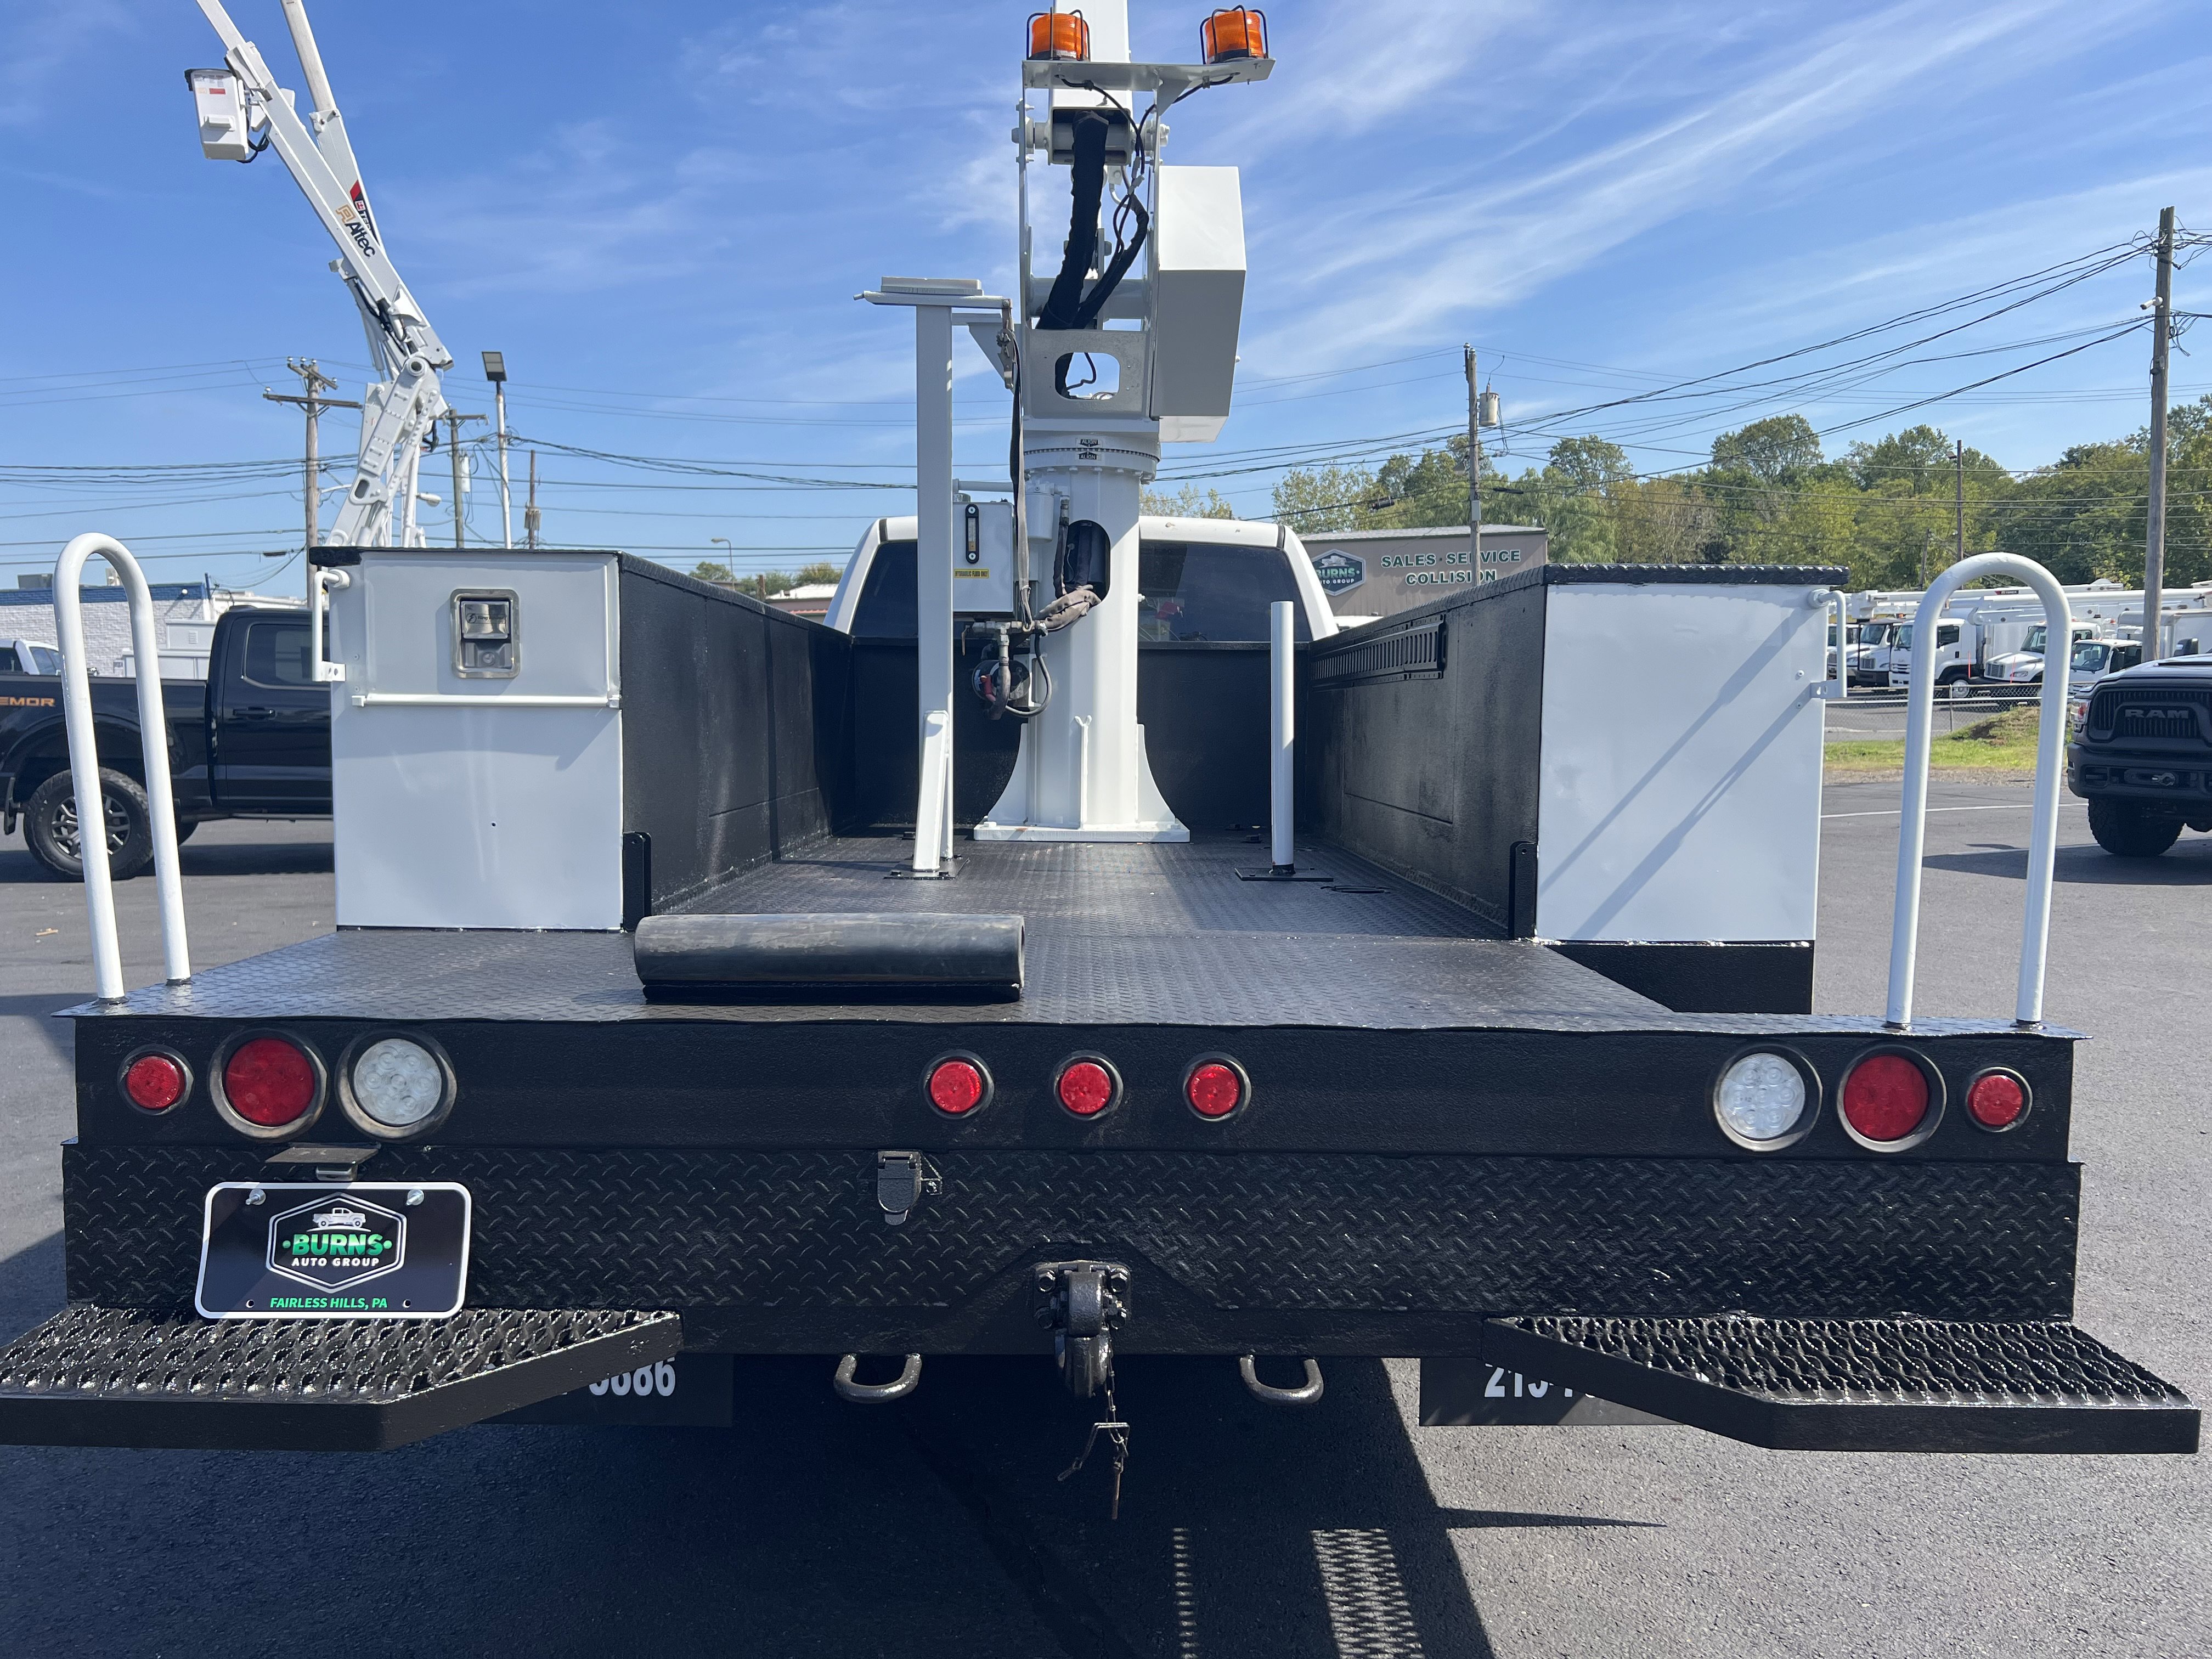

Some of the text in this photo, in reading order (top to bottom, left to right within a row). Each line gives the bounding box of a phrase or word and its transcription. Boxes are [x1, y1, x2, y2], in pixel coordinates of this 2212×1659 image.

[345, 222, 375, 257] Altec
[1381, 553, 1436, 568] SALES
[0, 696, 55, 707] EMOR
[2125, 709, 2189, 719] RAM
[292, 1233, 383, 1256] BURNS
[291, 1257, 380, 1267] AUTO GROUP
[270, 1297, 388, 1310] FAIRLESS HILLS, PA
